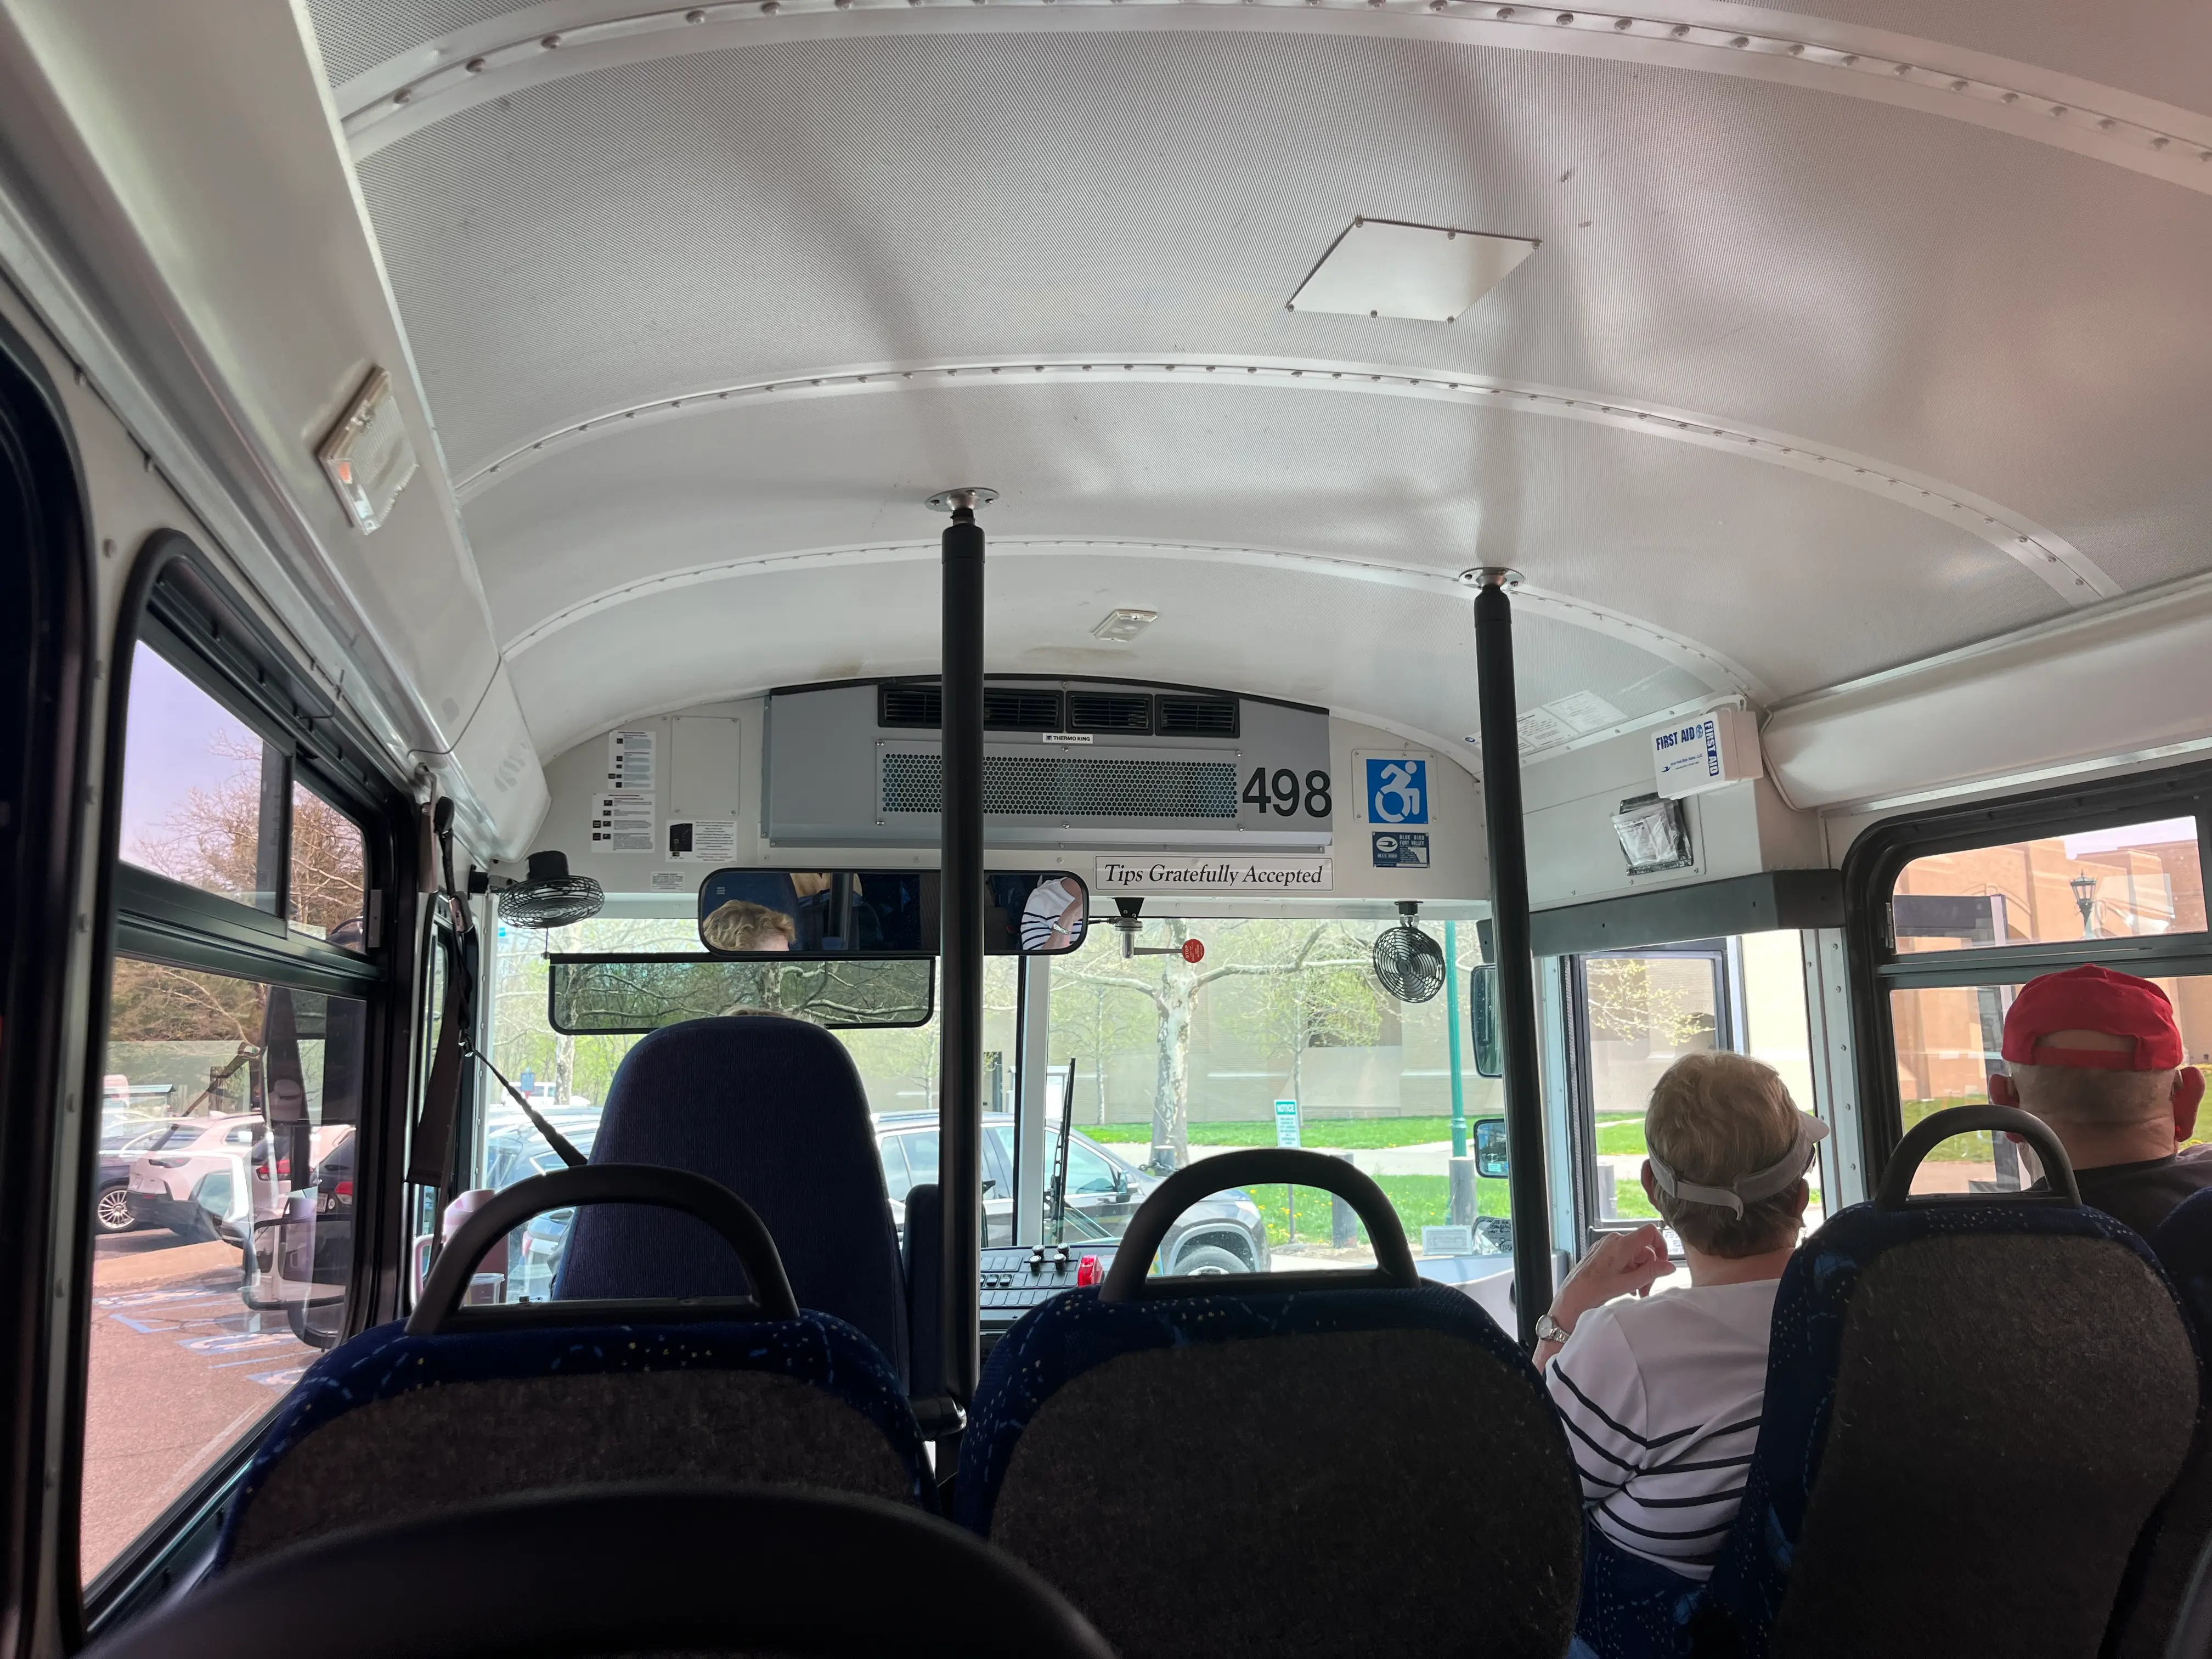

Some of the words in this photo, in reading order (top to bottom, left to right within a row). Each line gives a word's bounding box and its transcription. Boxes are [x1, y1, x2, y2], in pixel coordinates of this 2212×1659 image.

[1656, 731, 1678, 751] FIRST
[1681, 726, 1695, 743] AID
[1705, 722, 1716, 752] FIRST
[1708, 756, 1719, 774] AID
[1243, 767, 1332, 818] 498
[1104, 864, 1143, 886] Tips
[1149, 864, 1239, 886] Gratefully
[1242, 865, 1323, 887] Accepted
